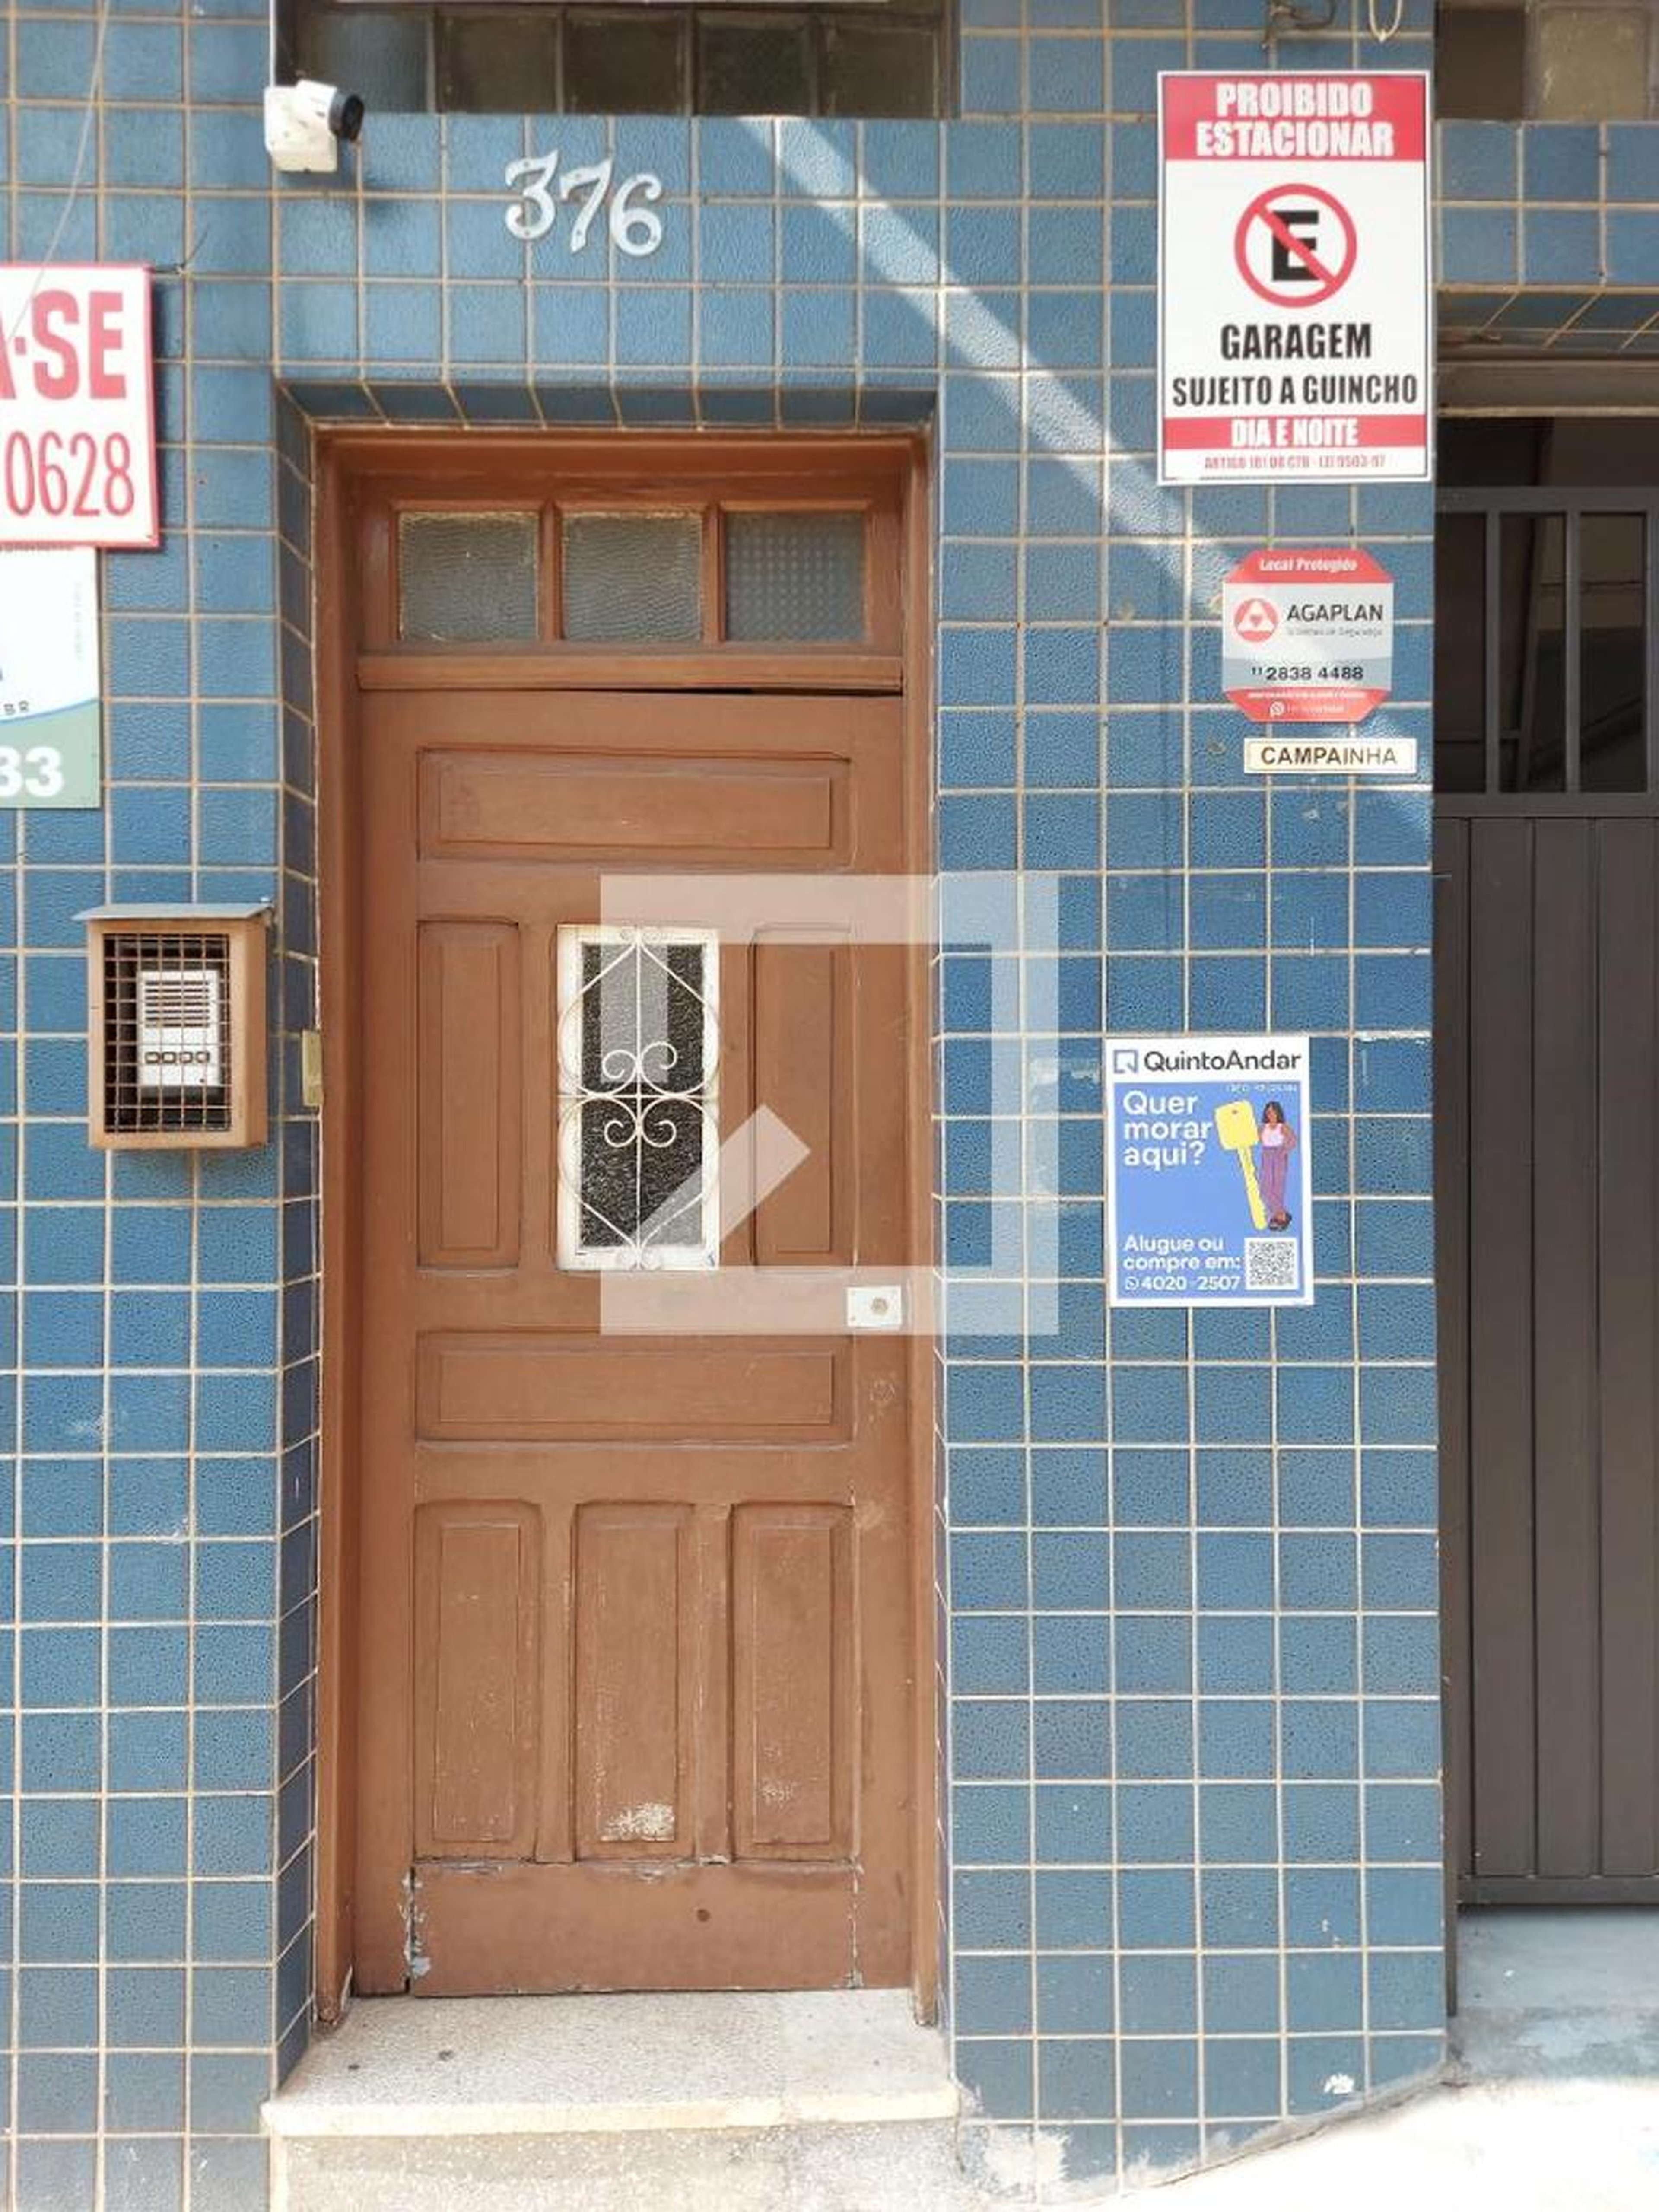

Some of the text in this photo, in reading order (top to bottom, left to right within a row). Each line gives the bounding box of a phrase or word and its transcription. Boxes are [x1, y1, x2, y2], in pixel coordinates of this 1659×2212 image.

[1217, 82, 1373, 117] PROIBIDO
[1196, 120, 1395, 157] ESTACIONAR
[505, 149, 663, 257] 376
[1272, 210, 1320, 281] E
[1220, 323, 1372, 360] GARAGEM
[1172, 374, 1417, 407] SUJEITO A GUINCHO
[1231, 418, 1359, 448] DIA E NOITE
[4, 430, 135, 517] 0628
[1259, 558, 1357, 573] Local Protegido
[1287, 604, 1383, 622] AGAPLAN
[1266, 666, 1312, 681] 2838
[1317, 666, 1363, 681] 4488
[1261, 747, 1398, 765] CAMPAINHA
[1144, 1050, 1302, 1072] QuintoAndar
[1123, 1090, 1198, 1115] Quer
[1124, 1120, 1212, 1139] morar
[1124, 1140, 1205, 1171] aqui?
[1124, 1235, 1224, 1255] Alugue ou
[1123, 1255, 1240, 1273] compre em:
